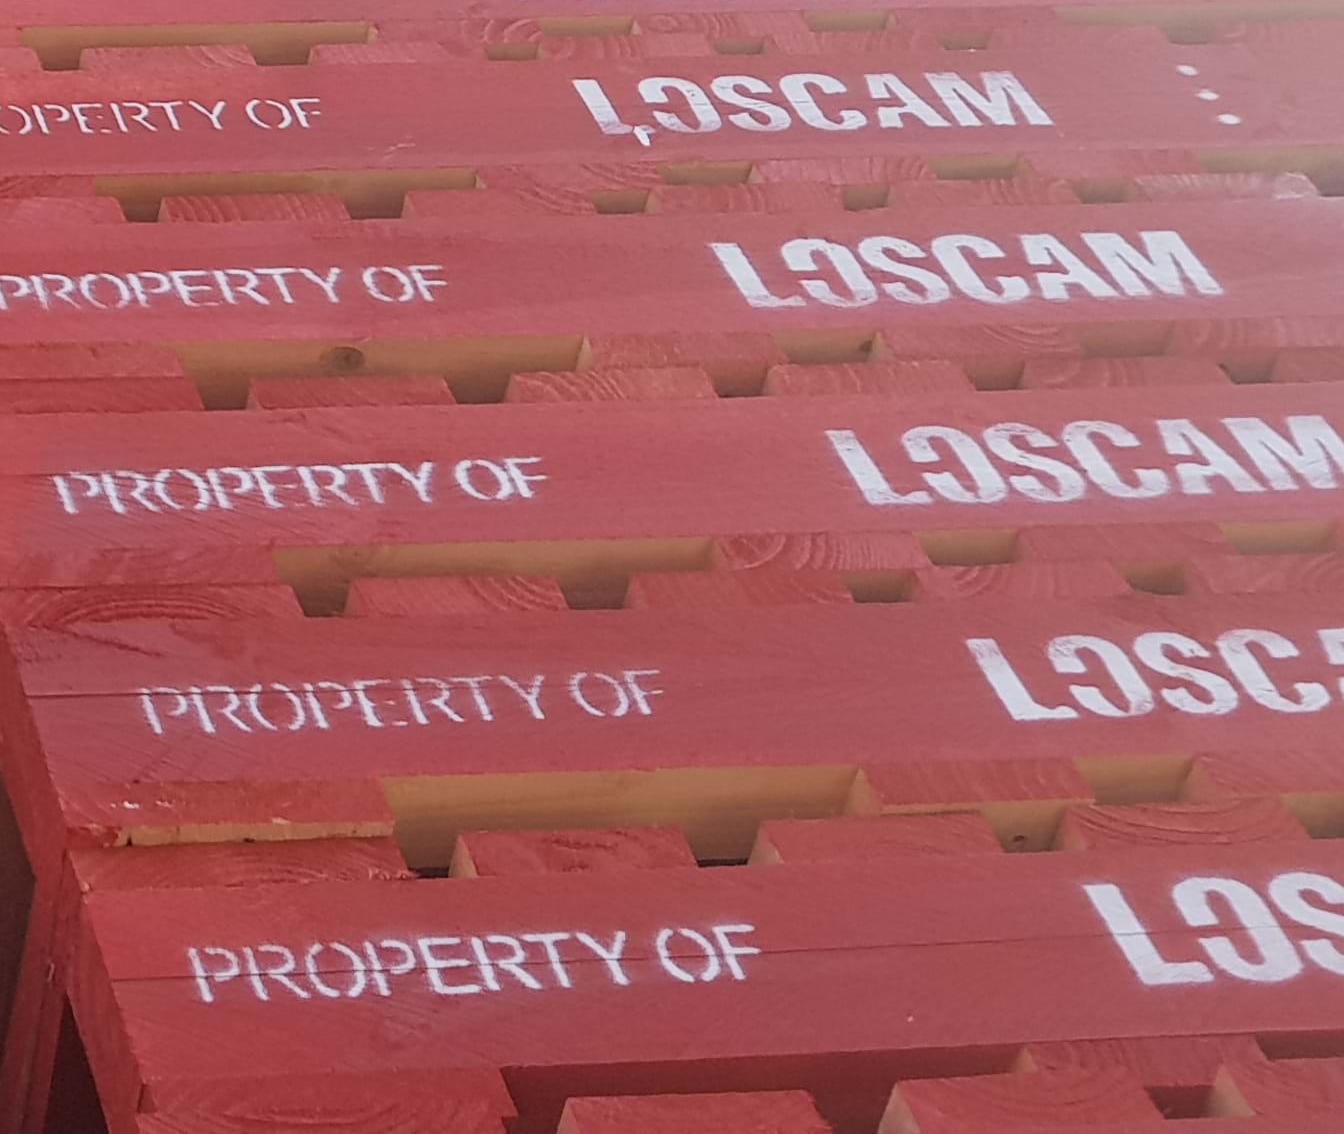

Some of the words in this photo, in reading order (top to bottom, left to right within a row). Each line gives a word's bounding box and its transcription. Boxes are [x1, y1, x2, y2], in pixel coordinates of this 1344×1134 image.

[246, 99, 320, 128] OF
[573, 71, 1053, 139] LOSCAM
[363, 265, 447, 301] OF
[710, 231, 1224, 307] LOSCAM
[53, 462, 432, 514] PROPERTY
[454, 457, 546, 499] OF
[139, 675, 544, 734] PROPERTY
[570, 670, 663, 716] OF
[966, 628, 1344, 720] LOSC
[188, 931, 629, 1002] PROPERTY
[655, 924, 760, 982] OF
